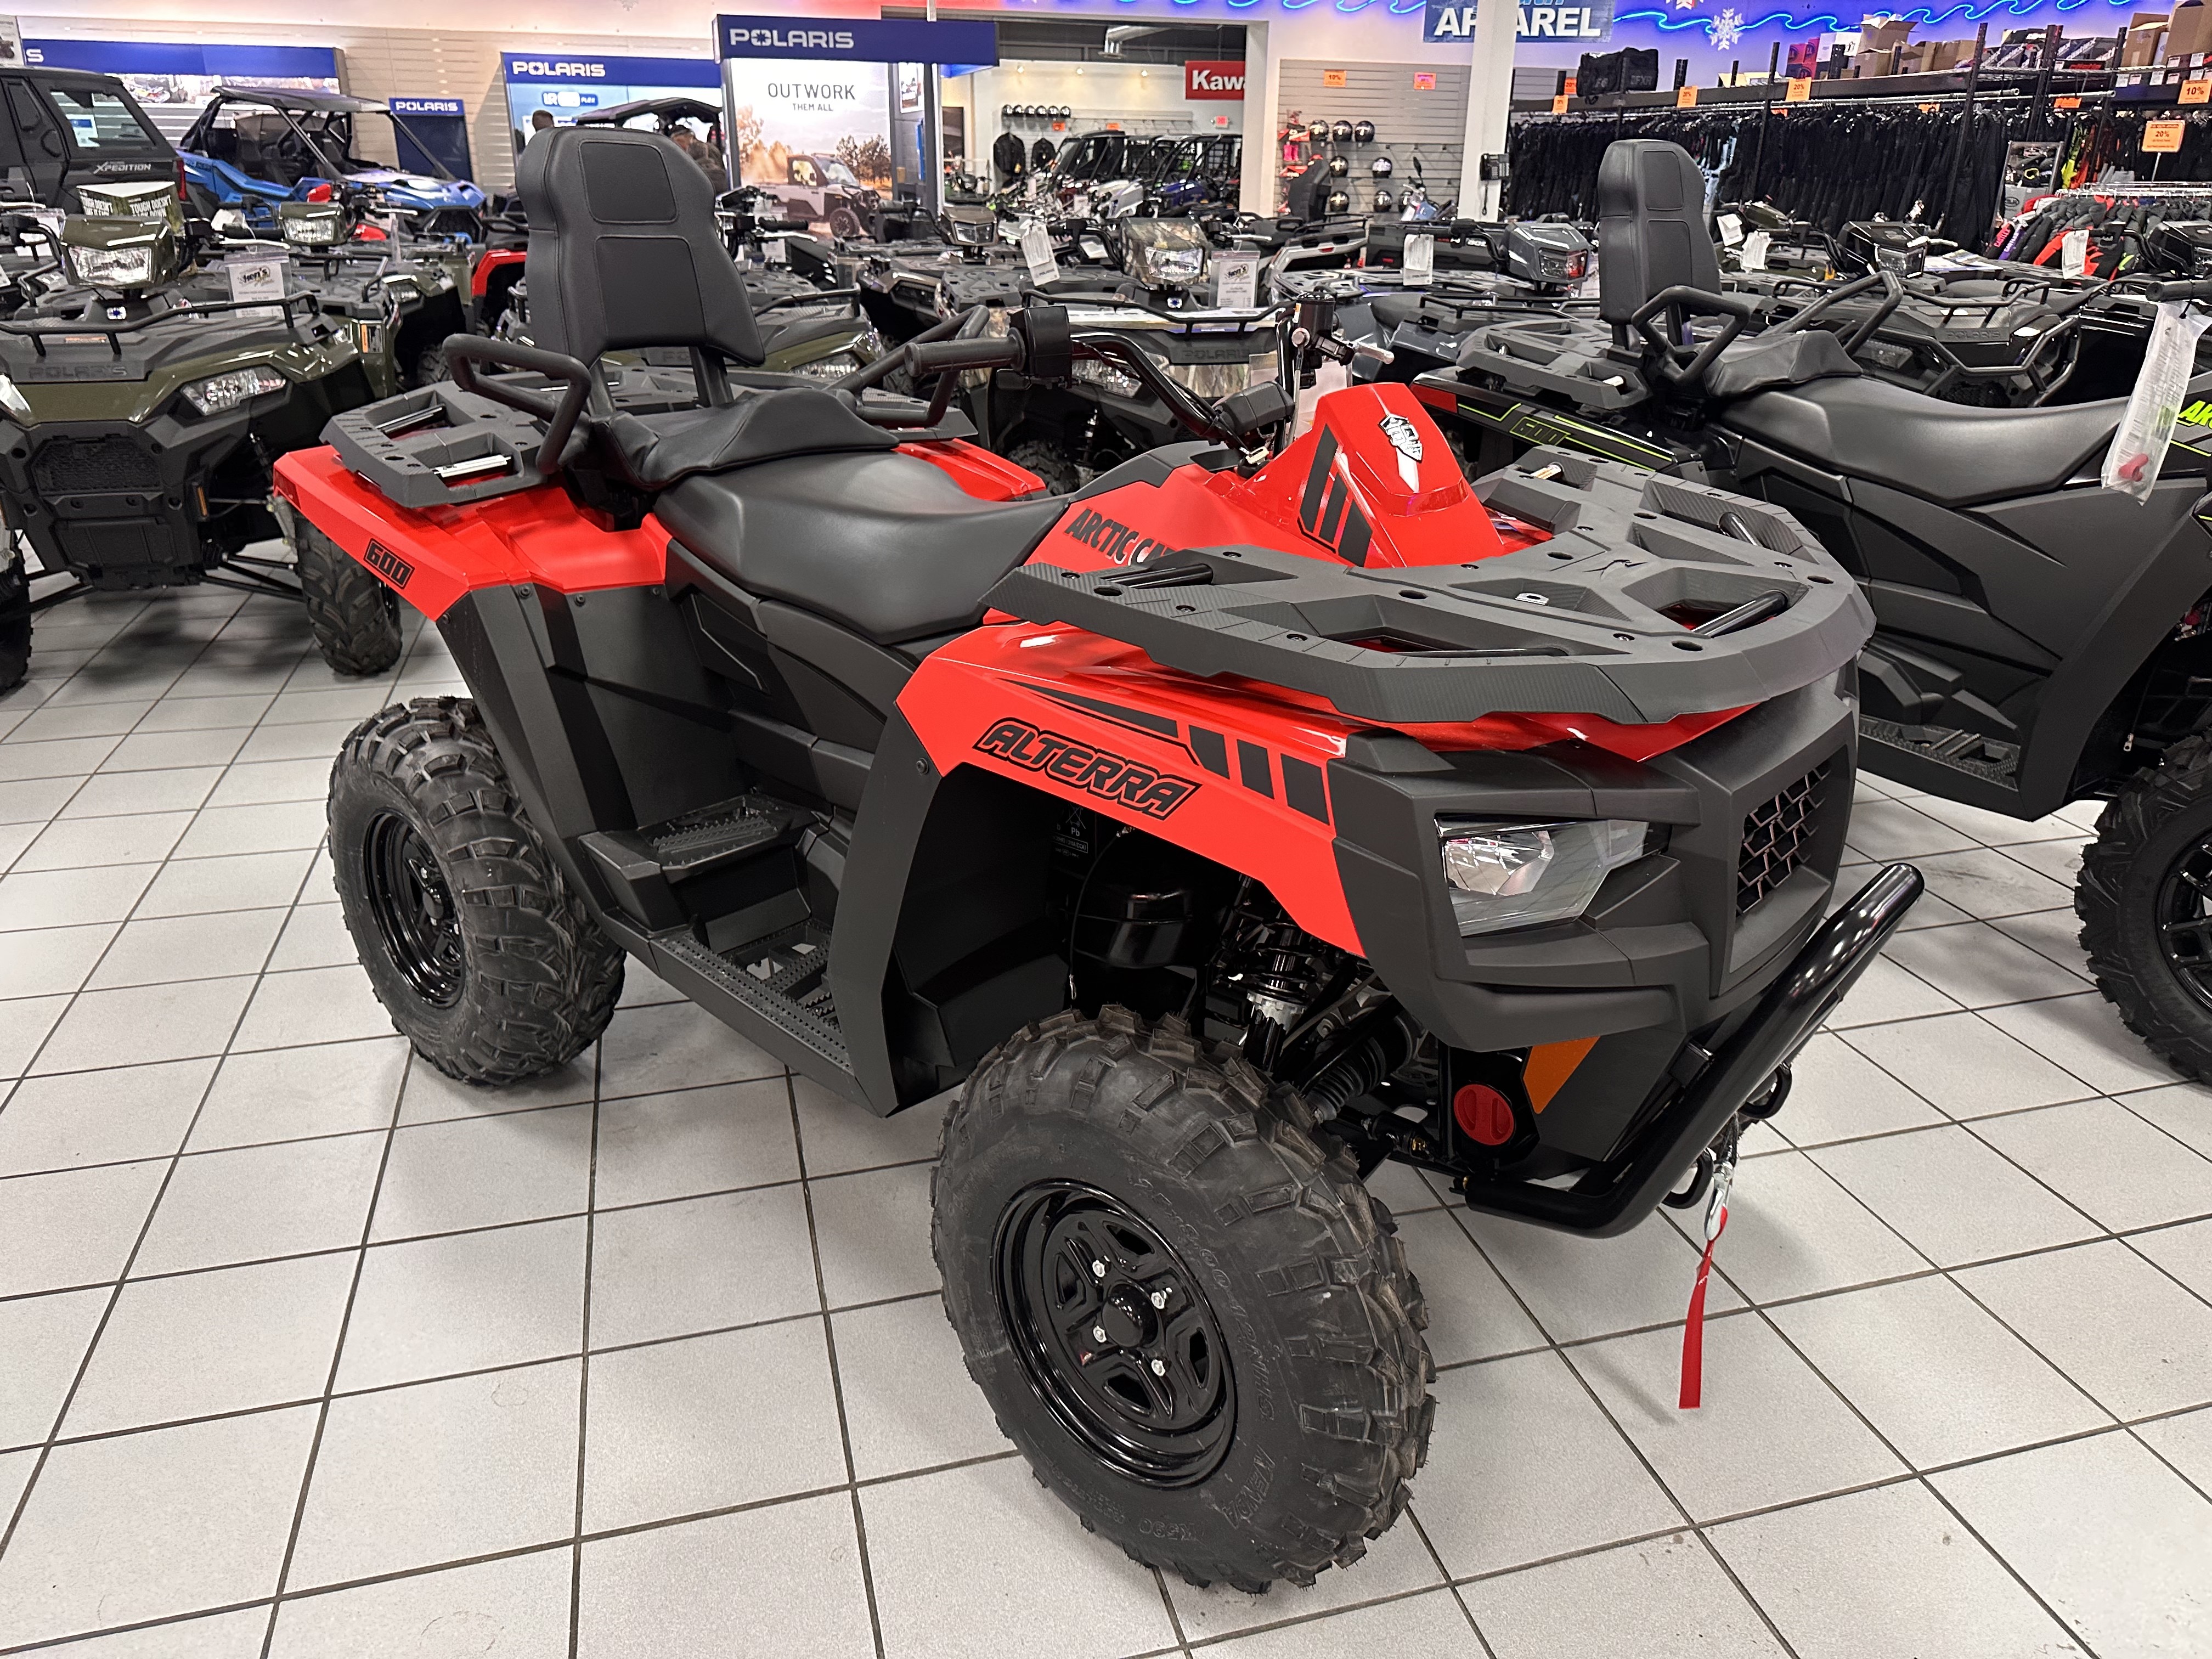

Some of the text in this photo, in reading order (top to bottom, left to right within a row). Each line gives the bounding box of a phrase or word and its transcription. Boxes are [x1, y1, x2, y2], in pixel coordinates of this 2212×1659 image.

[1434, 7, 1601, 37] APAREL
[730, 29, 854, 48] POLARIS
[512, 61, 606, 77] POLARIS
[1192, 70, 1245, 91] Kaw
[768, 83, 856, 100] OUTWORK
[2186, 87, 2204, 95] 10%
[395, 101, 458, 111] POLARIS
[93, 161, 151, 174] XPEDITION
[129, 200, 151, 216] TOUGH
[1510, 416, 1570, 445] 600
[1064, 507, 1178, 566] ARCTIC CA
[365, 540, 413, 586] 600
[980, 722, 1192, 814] ALTERRA
[1071, 826, 1080, 837] Pb
[1221, 1446, 1276, 1530] KENDA
